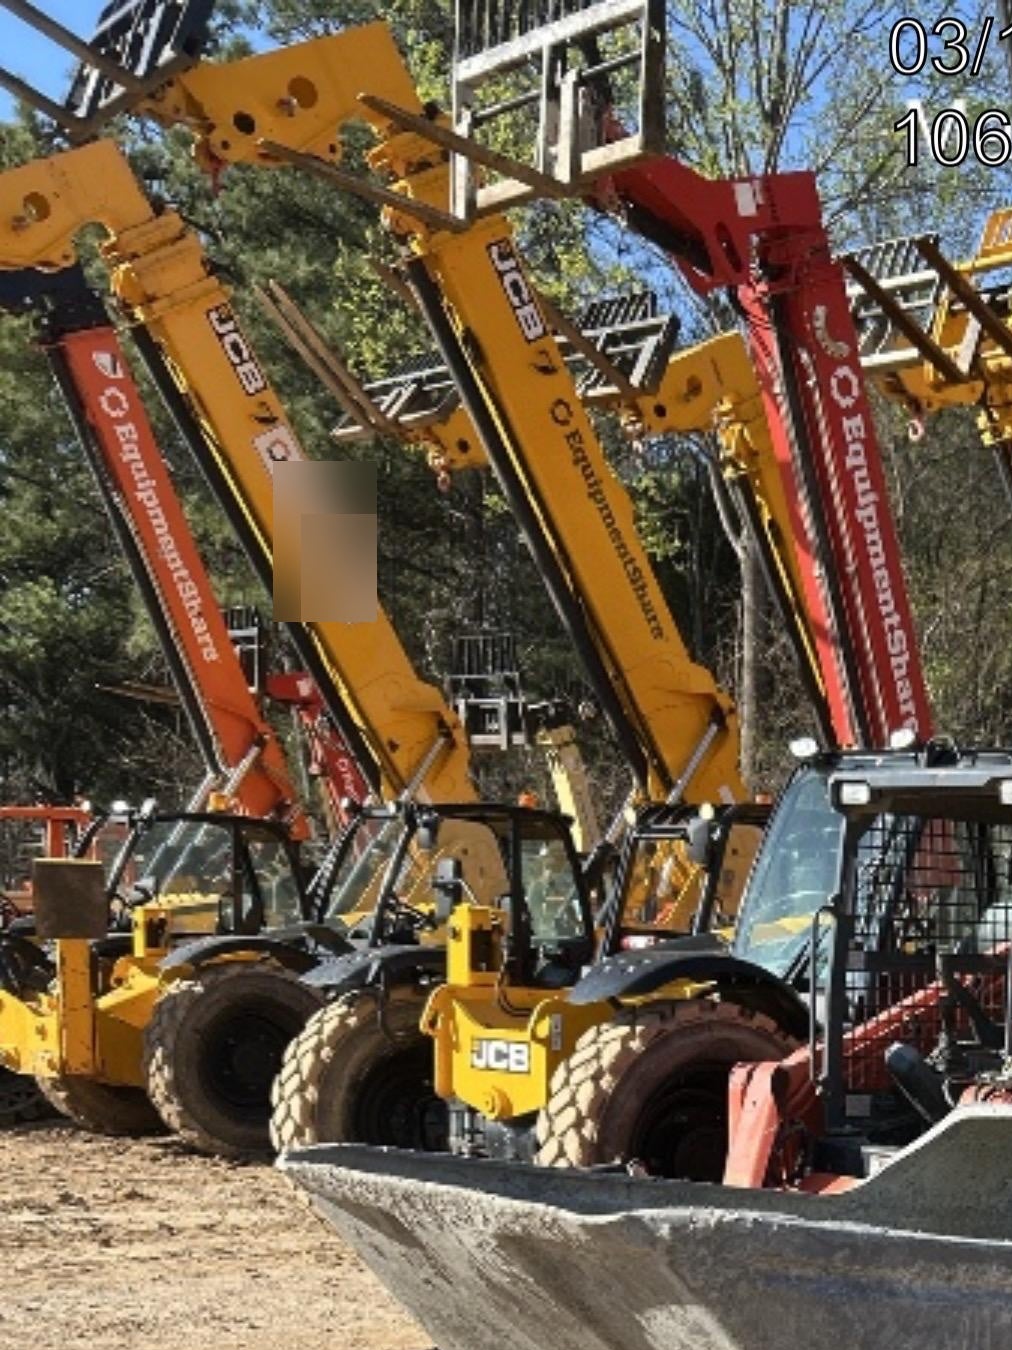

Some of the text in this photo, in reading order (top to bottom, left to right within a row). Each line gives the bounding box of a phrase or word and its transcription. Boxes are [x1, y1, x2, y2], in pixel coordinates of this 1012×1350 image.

[487, 236, 550, 344] JCB
[207, 302, 268, 395] JCB
[114, 421, 220, 663] EquipmentShare
[564, 427, 666, 642] EquipmentShare
[470, 1036, 531, 1074] JCB
